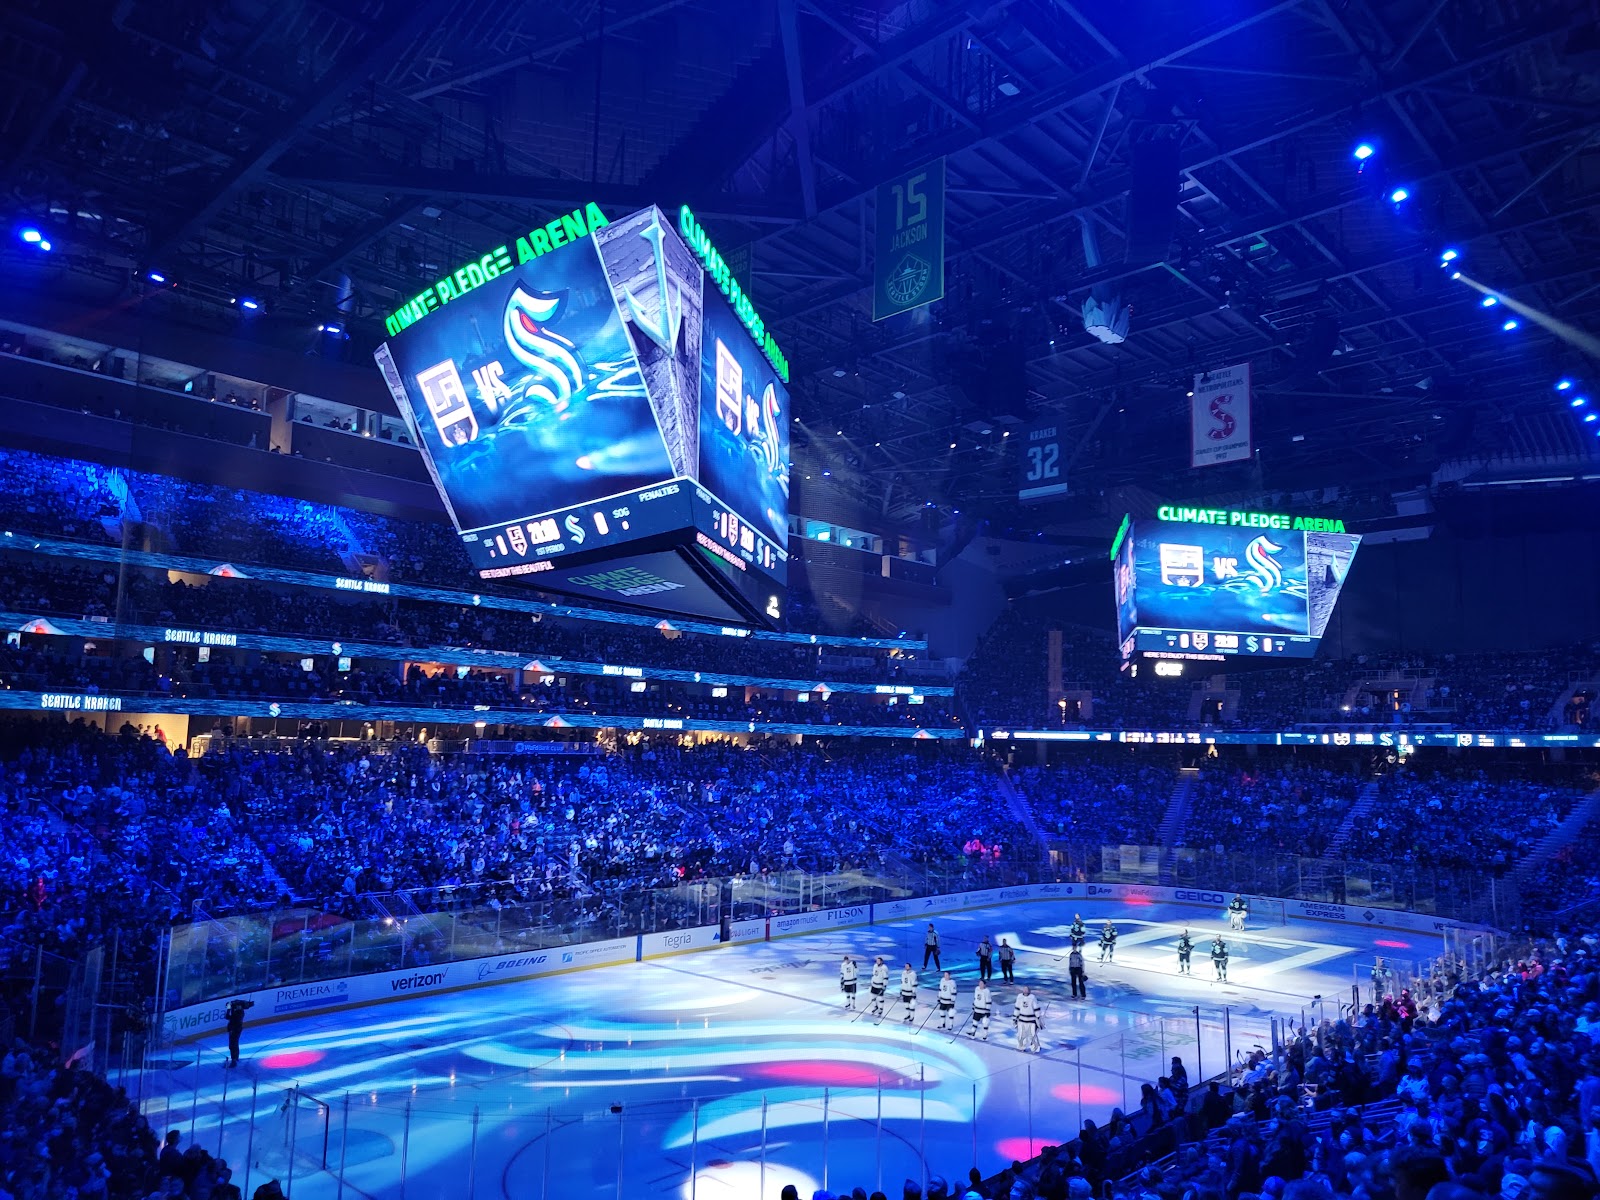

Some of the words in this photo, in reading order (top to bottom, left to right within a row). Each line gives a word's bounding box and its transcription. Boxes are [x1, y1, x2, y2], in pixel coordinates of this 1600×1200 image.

[892, 172, 927, 230] 15
[890, 223, 928, 253] JACKSON
[385, 287, 440, 337] CLIMATE
[435, 245, 514, 305] PLEDGE
[515, 201, 610, 266] ARENA
[887, 280, 910, 302] SEATTLE
[912, 267, 928, 297] STORM
[680, 204, 731, 295] CLIMATE
[729, 277, 765, 347] PLEDGE
[764, 331, 789, 384] ARENA
[471, 360, 513, 415] VS
[1198, 377, 1244, 394] METROPOLITANS
[1029, 427, 1057, 441] KRAKEN
[1027, 443, 1060, 481] 32
[639, 485, 680, 502] PENALTIES
[612, 507, 630, 518] SOG
[1158, 506, 1228, 525] CLIMATE
[1229, 511, 1290, 530] PLEDGE
[1293, 516, 1346, 534] ARENA
[567, 566, 648, 586] CLIMATE
[1213, 557, 1239, 580] VS
[335, 577, 363, 591] SEATTLE
[363, 581, 391, 595] KRAKEN
[590, 575, 667, 592] PLEDGE
[617, 581, 686, 597] ARENA
[165, 628, 201, 643] SEATTLE
[203, 632, 237, 647] KRAKEN
[1197, 654, 1227, 662] BEAUTIFUL
[41, 694, 82, 709] SEATTLE
[84, 695, 122, 712] KRAKEN
[1098, 887, 1112, 895] App
[1175, 890, 1225, 904] GEICO
[1300, 902, 1345, 913] AMERICAN
[1306, 910, 1346, 920] EXPRESS
[742, 928, 760, 937] LIGHT
[776, 919, 799, 929] amazon
[800, 915, 818, 925] music
[827, 908, 863, 921] FILSON
[662, 934, 691, 949] Tegria
[496, 955, 548, 970] BOEING
[391, 972, 442, 991] verizon
[276, 985, 331, 1003] PREMERA
[180, 1010, 212, 1030] WaFd
[212, 1008, 227, 1022] Ba
